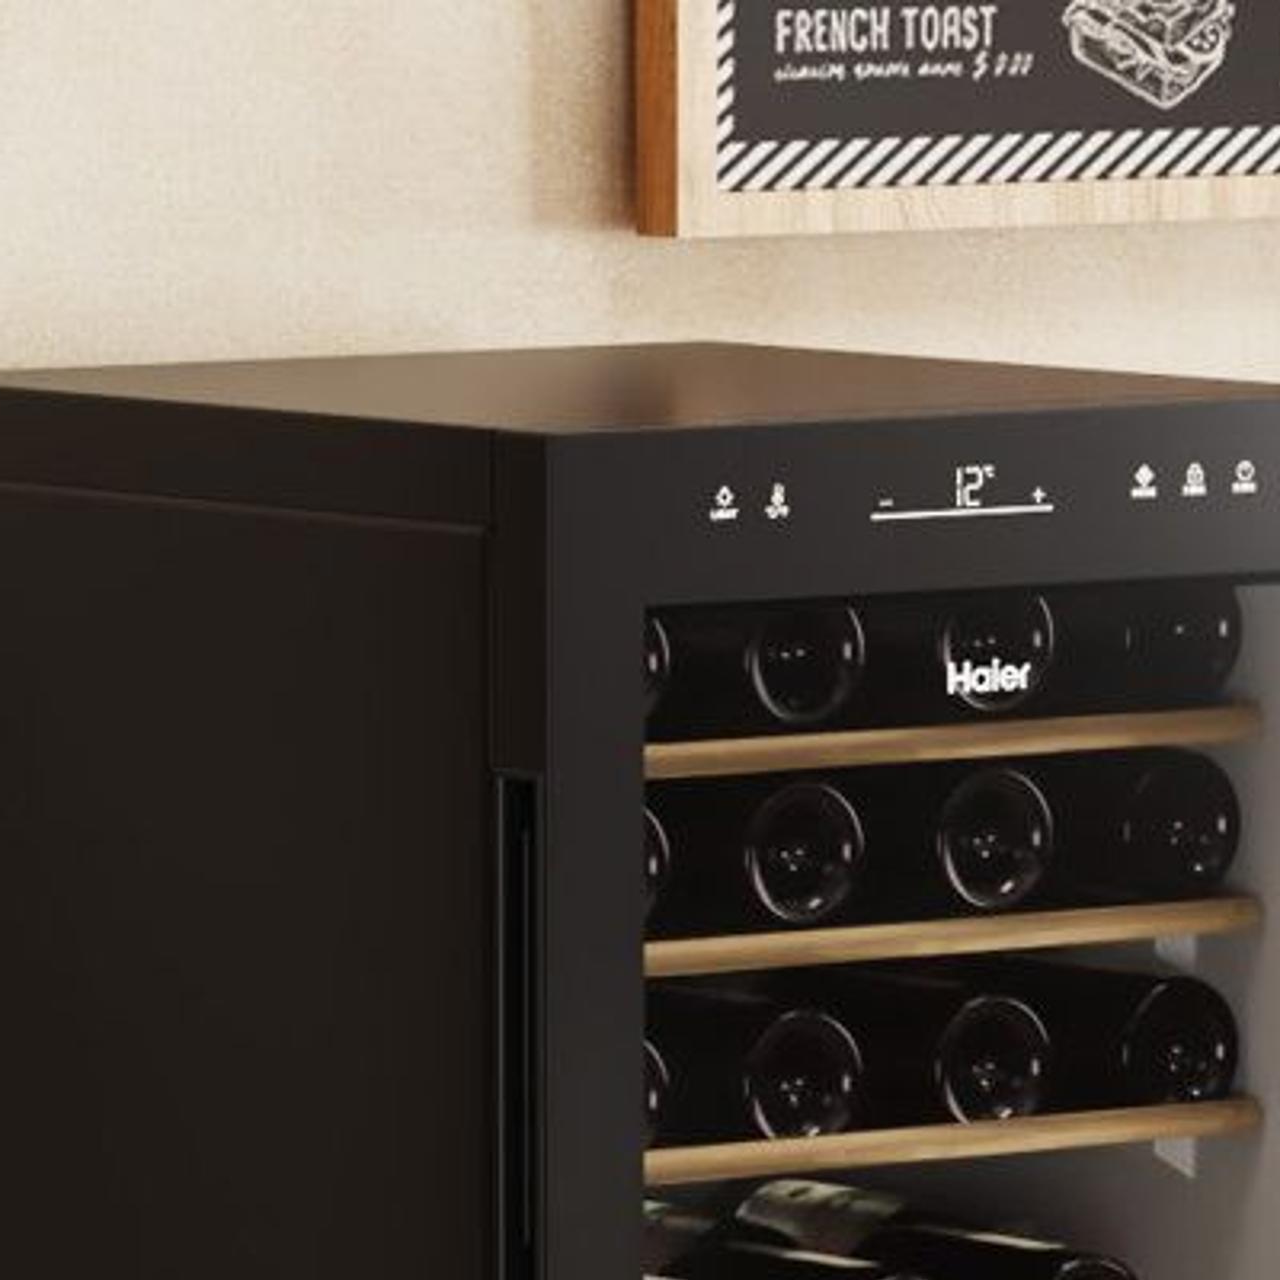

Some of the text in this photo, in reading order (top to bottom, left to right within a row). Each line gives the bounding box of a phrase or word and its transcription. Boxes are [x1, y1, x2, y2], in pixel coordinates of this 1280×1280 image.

[775, 5, 998, 53] FRENCH TOAST
[946, 657, 1031, 695] Haier
